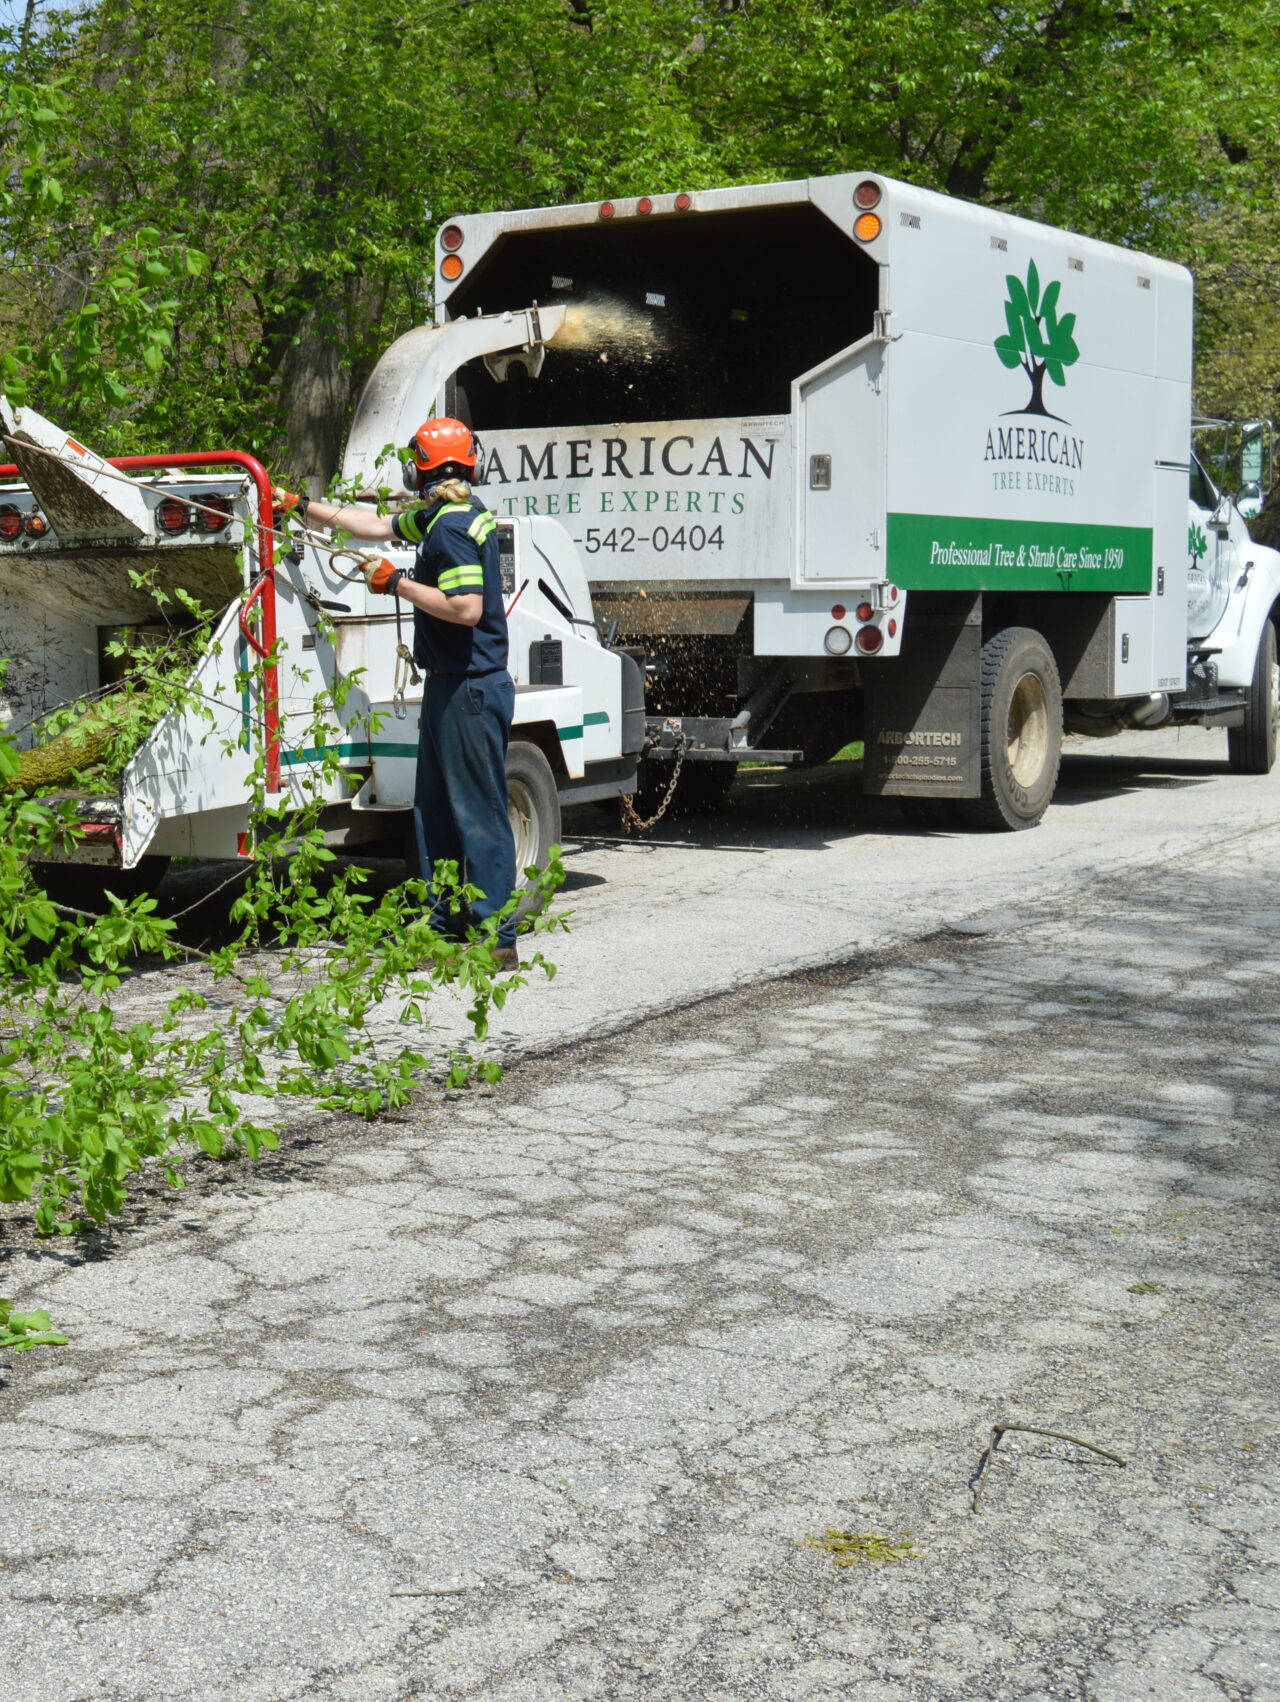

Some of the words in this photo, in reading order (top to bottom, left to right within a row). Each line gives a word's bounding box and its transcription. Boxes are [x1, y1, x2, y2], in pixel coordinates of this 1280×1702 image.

[481, 436, 780, 485] AMERICAN
[984, 427, 1084, 471] AMERICAN
[993, 472, 1021, 490] TREE
[1027, 472, 1075, 497] EXPERTS
[503, 492, 582, 516] TREE
[600, 490, 745, 515] EXPERTS
[930, 541, 992, 566] Professional
[995, 544, 1015, 566] Tree
[1017, 545, 1026, 567] &
[1028, 545, 1055, 568] Shrub
[1057, 546, 1078, 568] Care
[1079, 547, 1102, 569] Since
[1104, 548, 1124, 569] 1950
[877, 731, 961, 747] ARBORTECH
